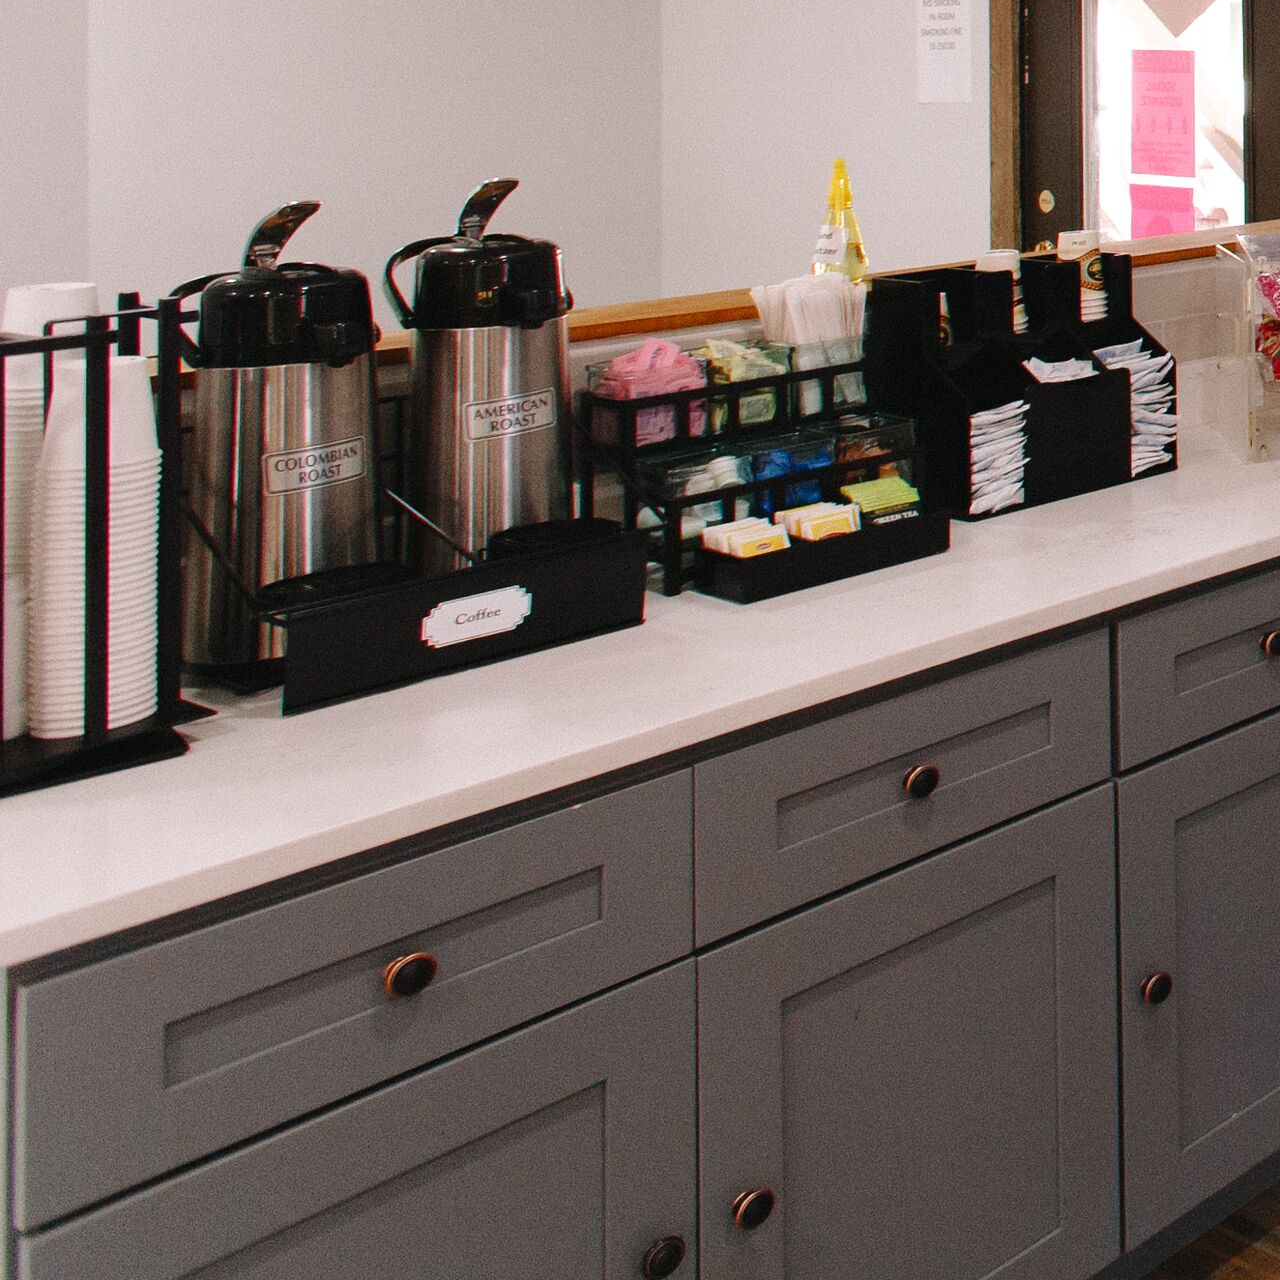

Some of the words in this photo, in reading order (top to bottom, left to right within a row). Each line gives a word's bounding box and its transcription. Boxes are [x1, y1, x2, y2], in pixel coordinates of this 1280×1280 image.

[473, 396, 548, 421] AMERICAN
[490, 413, 537, 432] ROAST
[274, 446, 358, 473] COLOMBIAN
[299, 463, 342, 484] ROAST
[902, 510, 919, 519] TEA
[455, 606, 502, 626] Coffee
